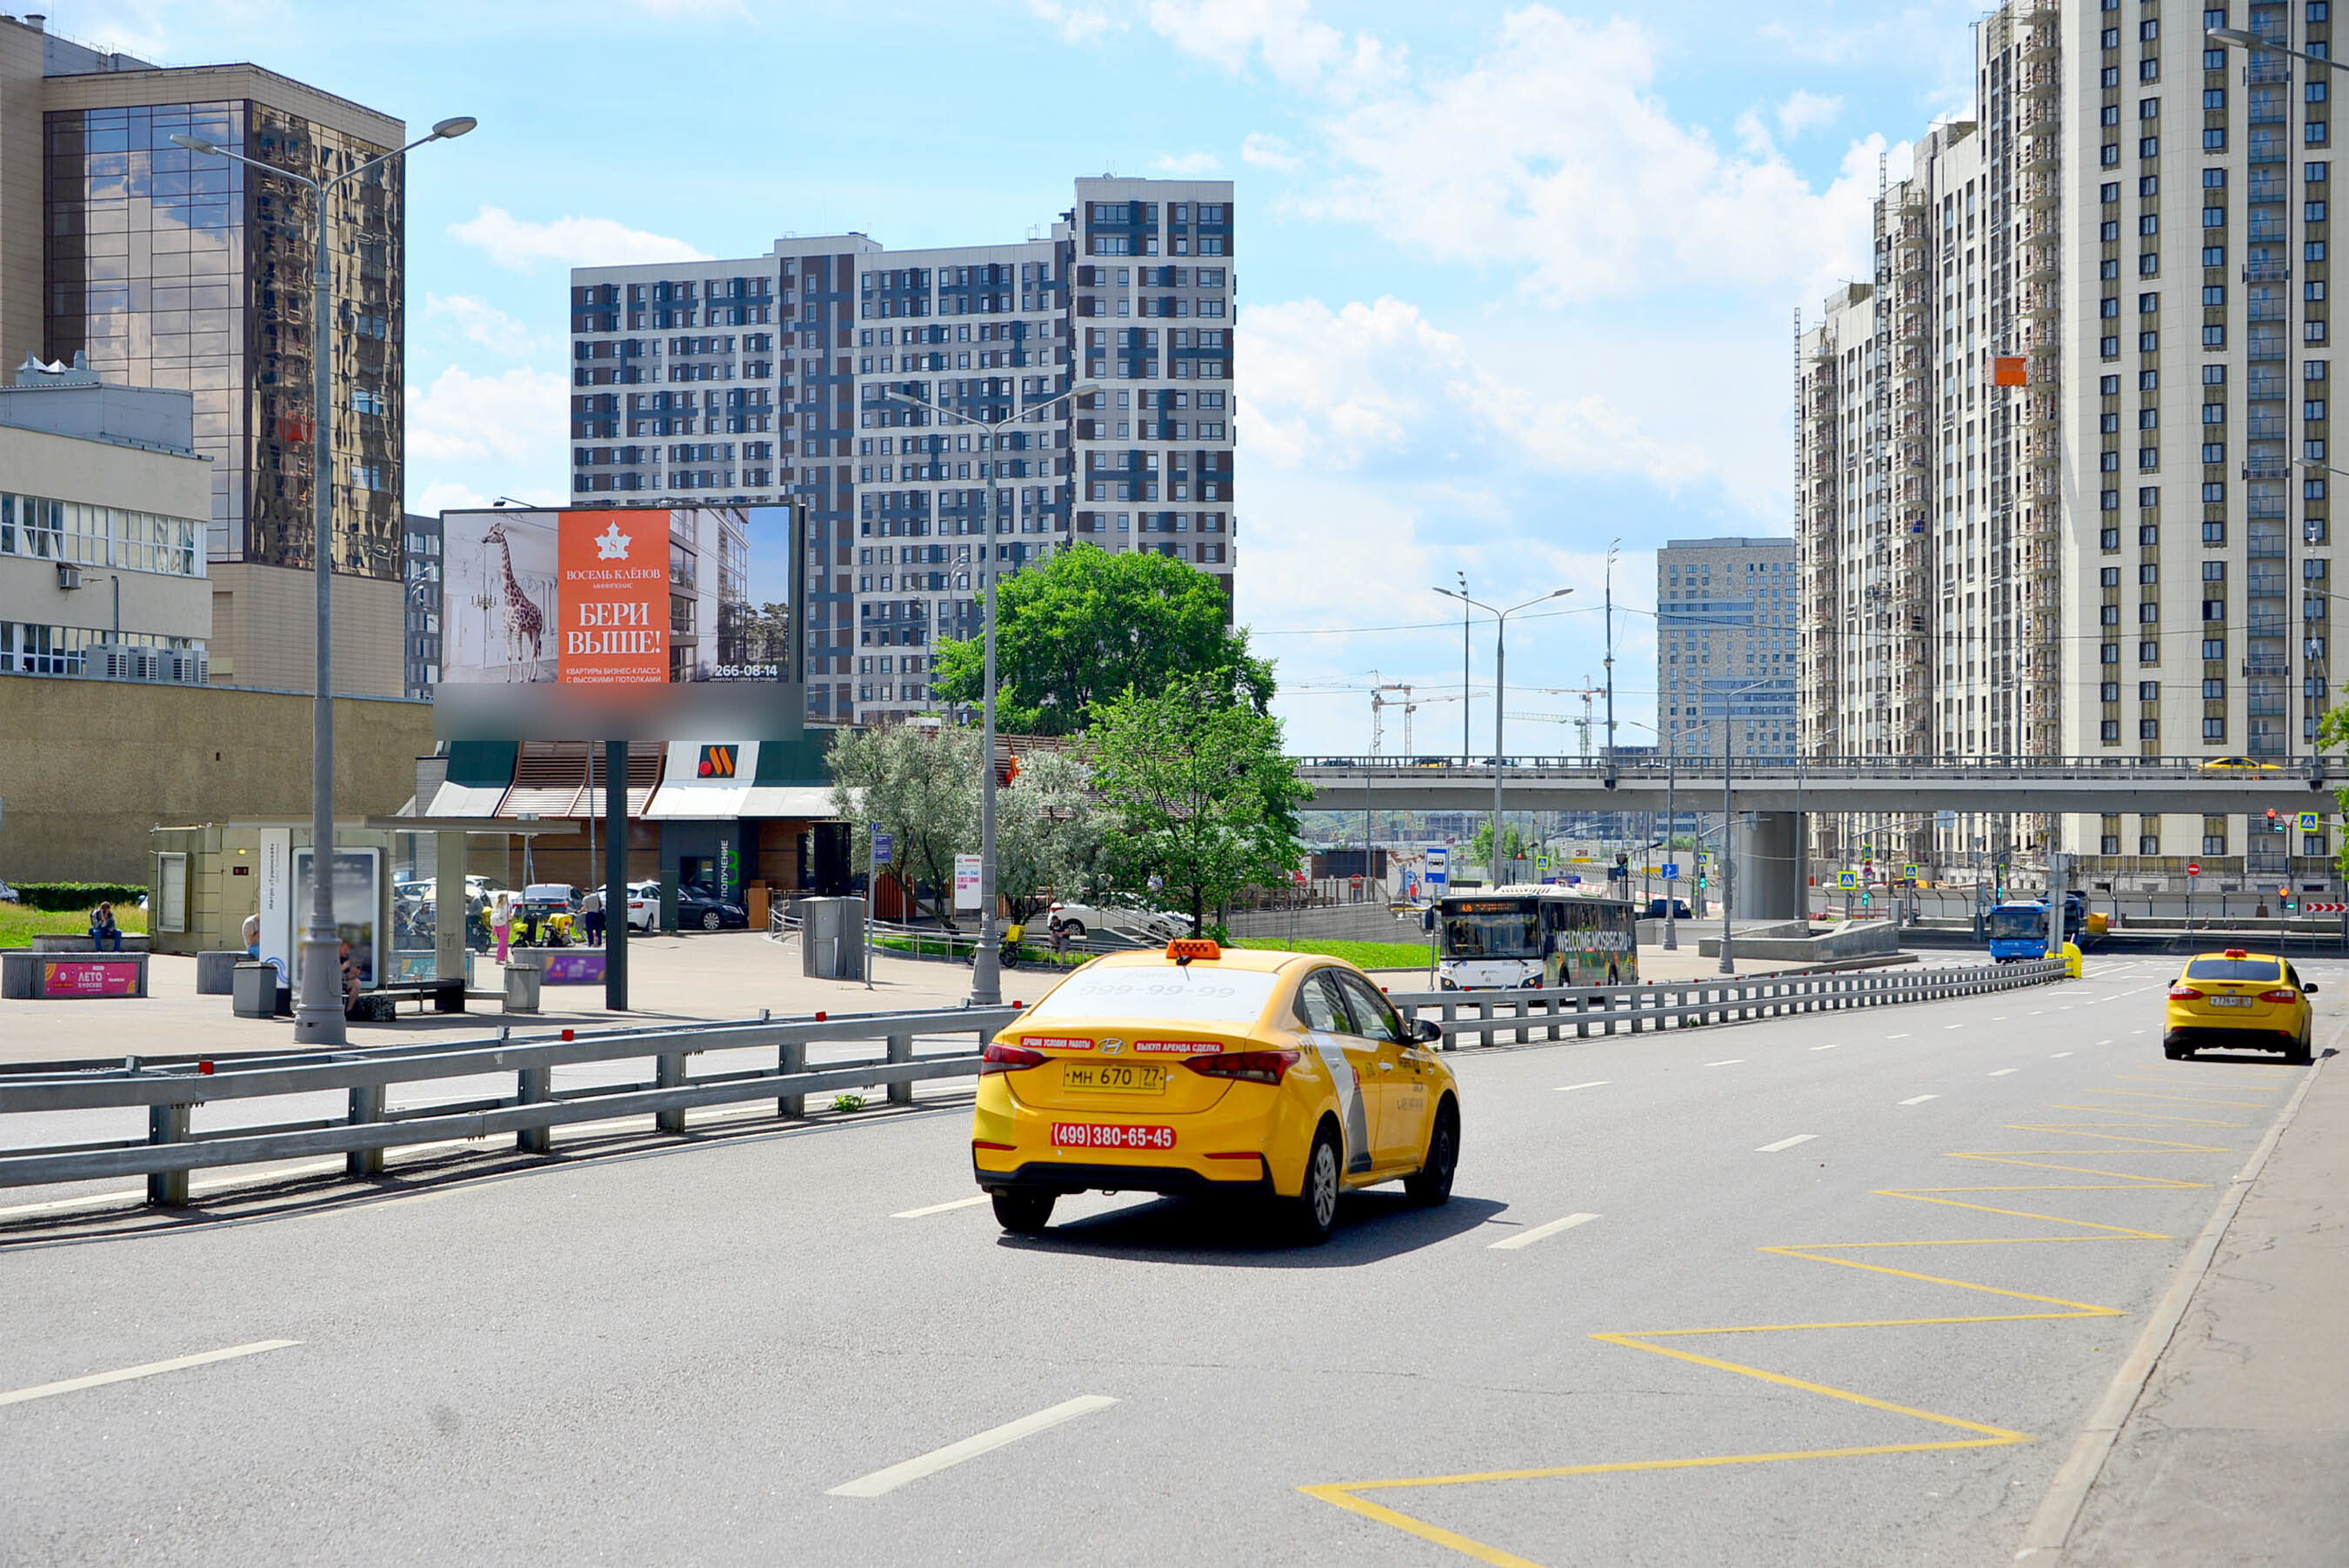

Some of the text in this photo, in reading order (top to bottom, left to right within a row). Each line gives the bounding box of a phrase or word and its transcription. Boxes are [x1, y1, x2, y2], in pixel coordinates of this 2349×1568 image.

[566, 567, 661, 580] ВОСЕМЬ КЛЁНОВ
[578, 603, 649, 626] БЕРИ
[567, 631, 661, 655] ВЫШЕ!
[715, 664, 777, 677] 266-08-14
[78, 972, 103, 982] ЛЕТО
[1068, 1040, 1091, 1049] РАБОТЫ
[1136, 1043, 1220, 1053] ВЫКУП АРЕНДА СДЕЛКА
[1071, 1068, 1158, 1085] МН 670 77
